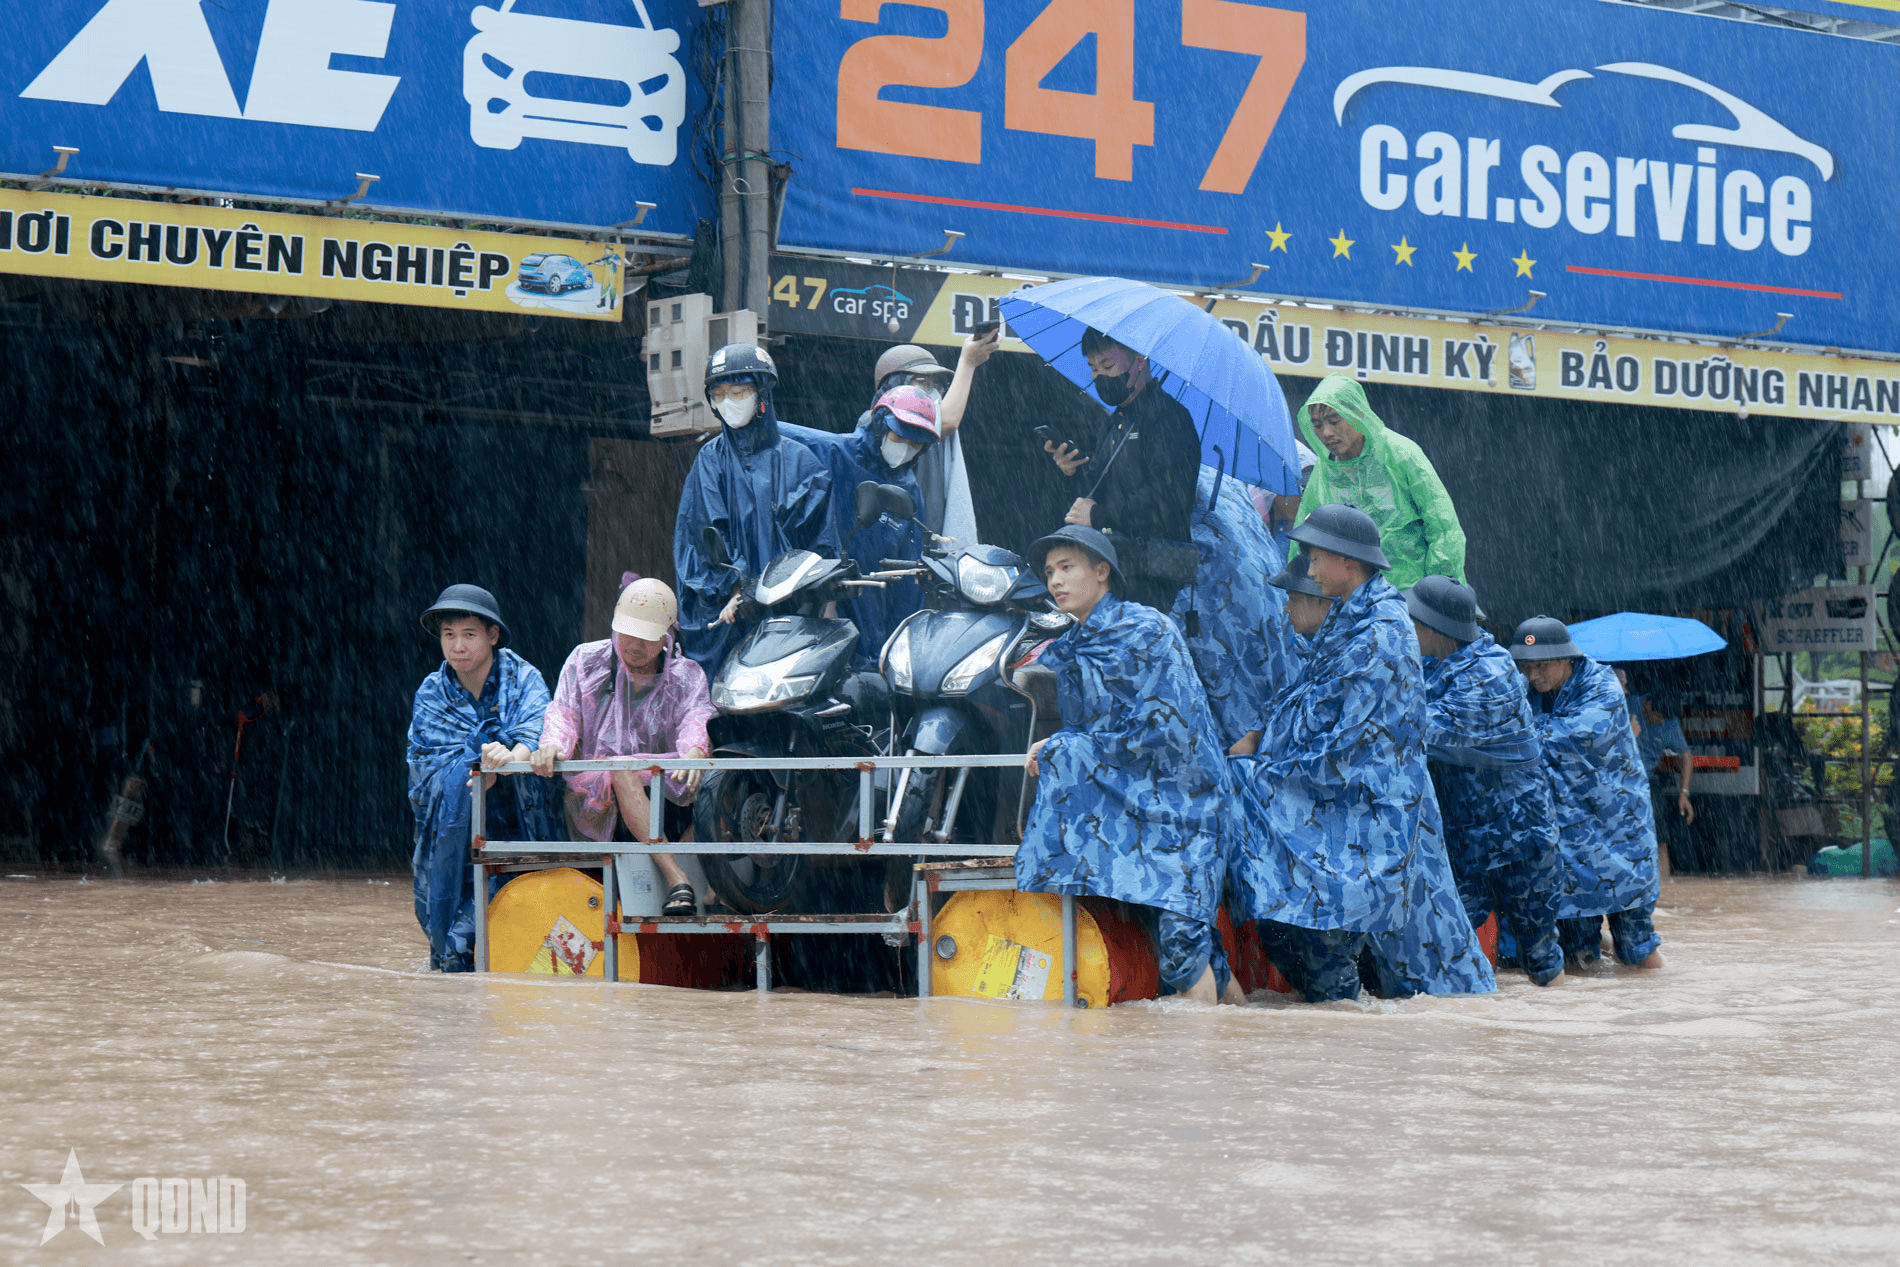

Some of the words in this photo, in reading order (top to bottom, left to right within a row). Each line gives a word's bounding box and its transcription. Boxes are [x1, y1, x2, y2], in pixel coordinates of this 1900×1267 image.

[836, 0, 1307, 195] 247
[1359, 124, 1813, 257] car.service
[90, 218, 304, 275] CHUYÊN
[322, 239, 510, 296] NGHIỆP
[768, 275, 827, 310] 47
[833, 295, 866, 315] car
[872, 300, 909, 323] spa
[1325, 329, 1429, 379] ĐỊNH
[1445, 333, 1495, 380] KỲ
[1561, 340, 1639, 392] BẢO
[1655, 356, 1785, 405] DƯỠNG
[1799, 372, 1900, 414] NHAN
